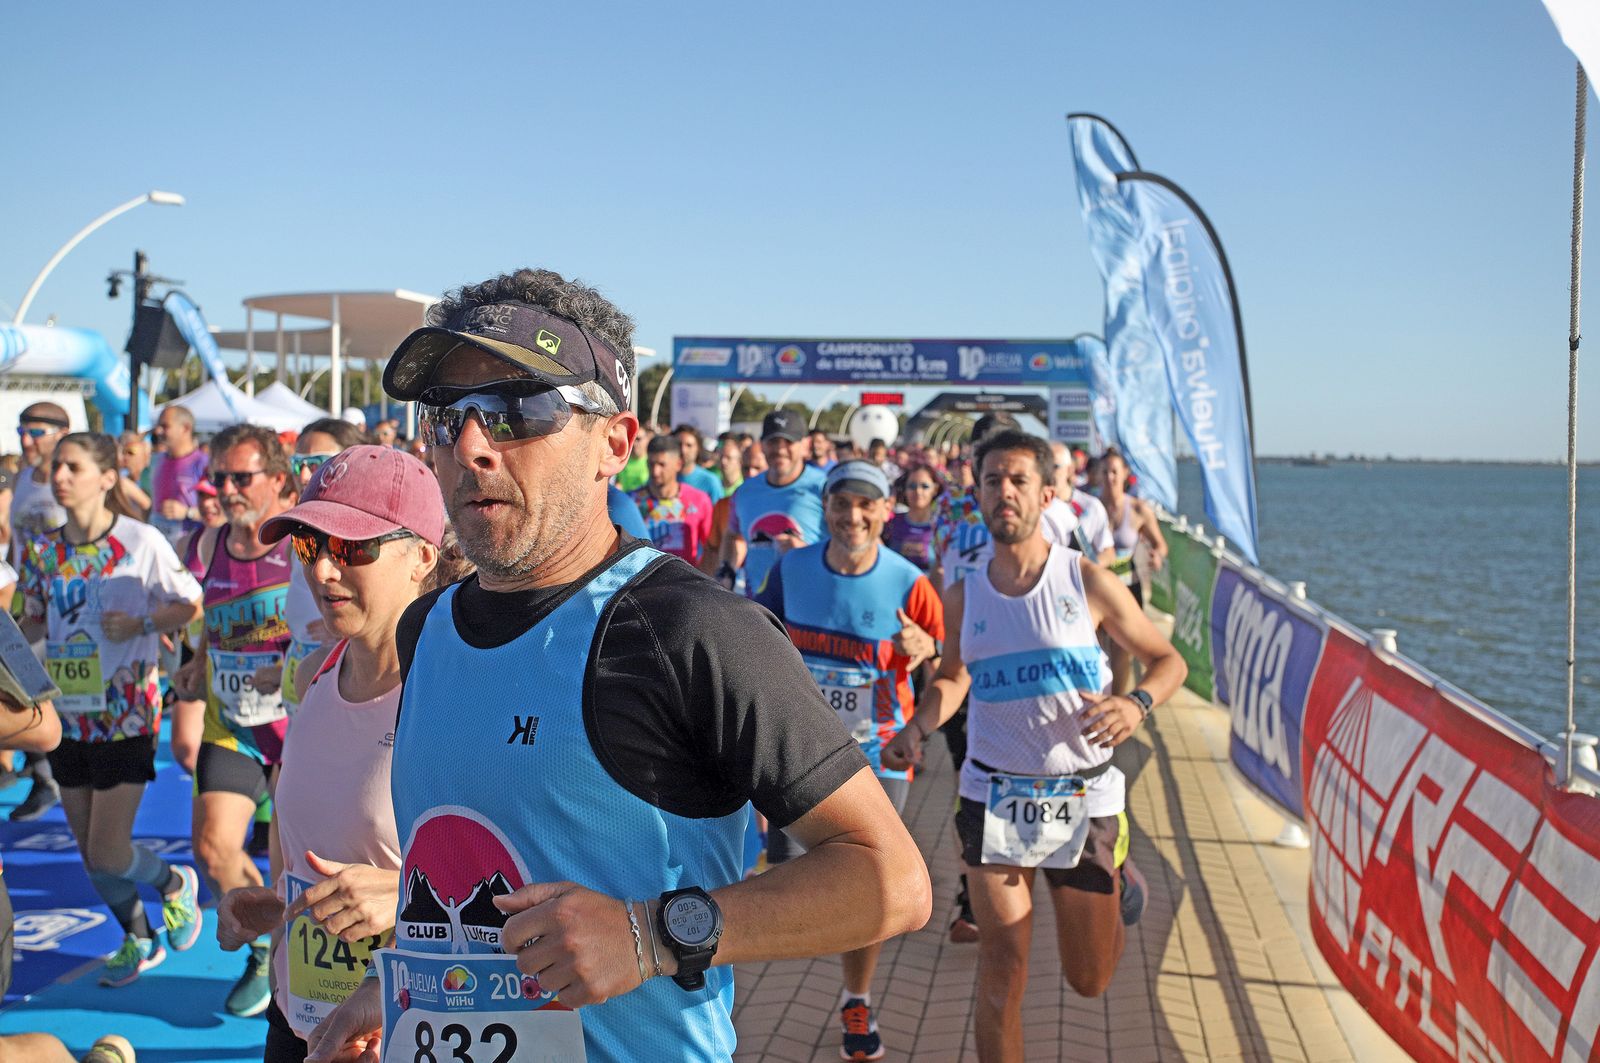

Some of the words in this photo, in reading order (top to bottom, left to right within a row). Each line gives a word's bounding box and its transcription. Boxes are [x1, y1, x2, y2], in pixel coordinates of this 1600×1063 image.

[817, 343, 914, 356] CAMPEONATO
[890, 356, 914, 371] 10
[916, 354, 948, 372] km
[1006, 800, 1072, 825] 1084
[407, 925, 448, 939] CLUB
[467, 928, 499, 944] Ultra
[318, 978, 360, 991] LOURDES
[408, 973, 438, 993] HUELVA
[445, 996, 474, 1006] WiHu
[414, 1020, 518, 1063] 832
